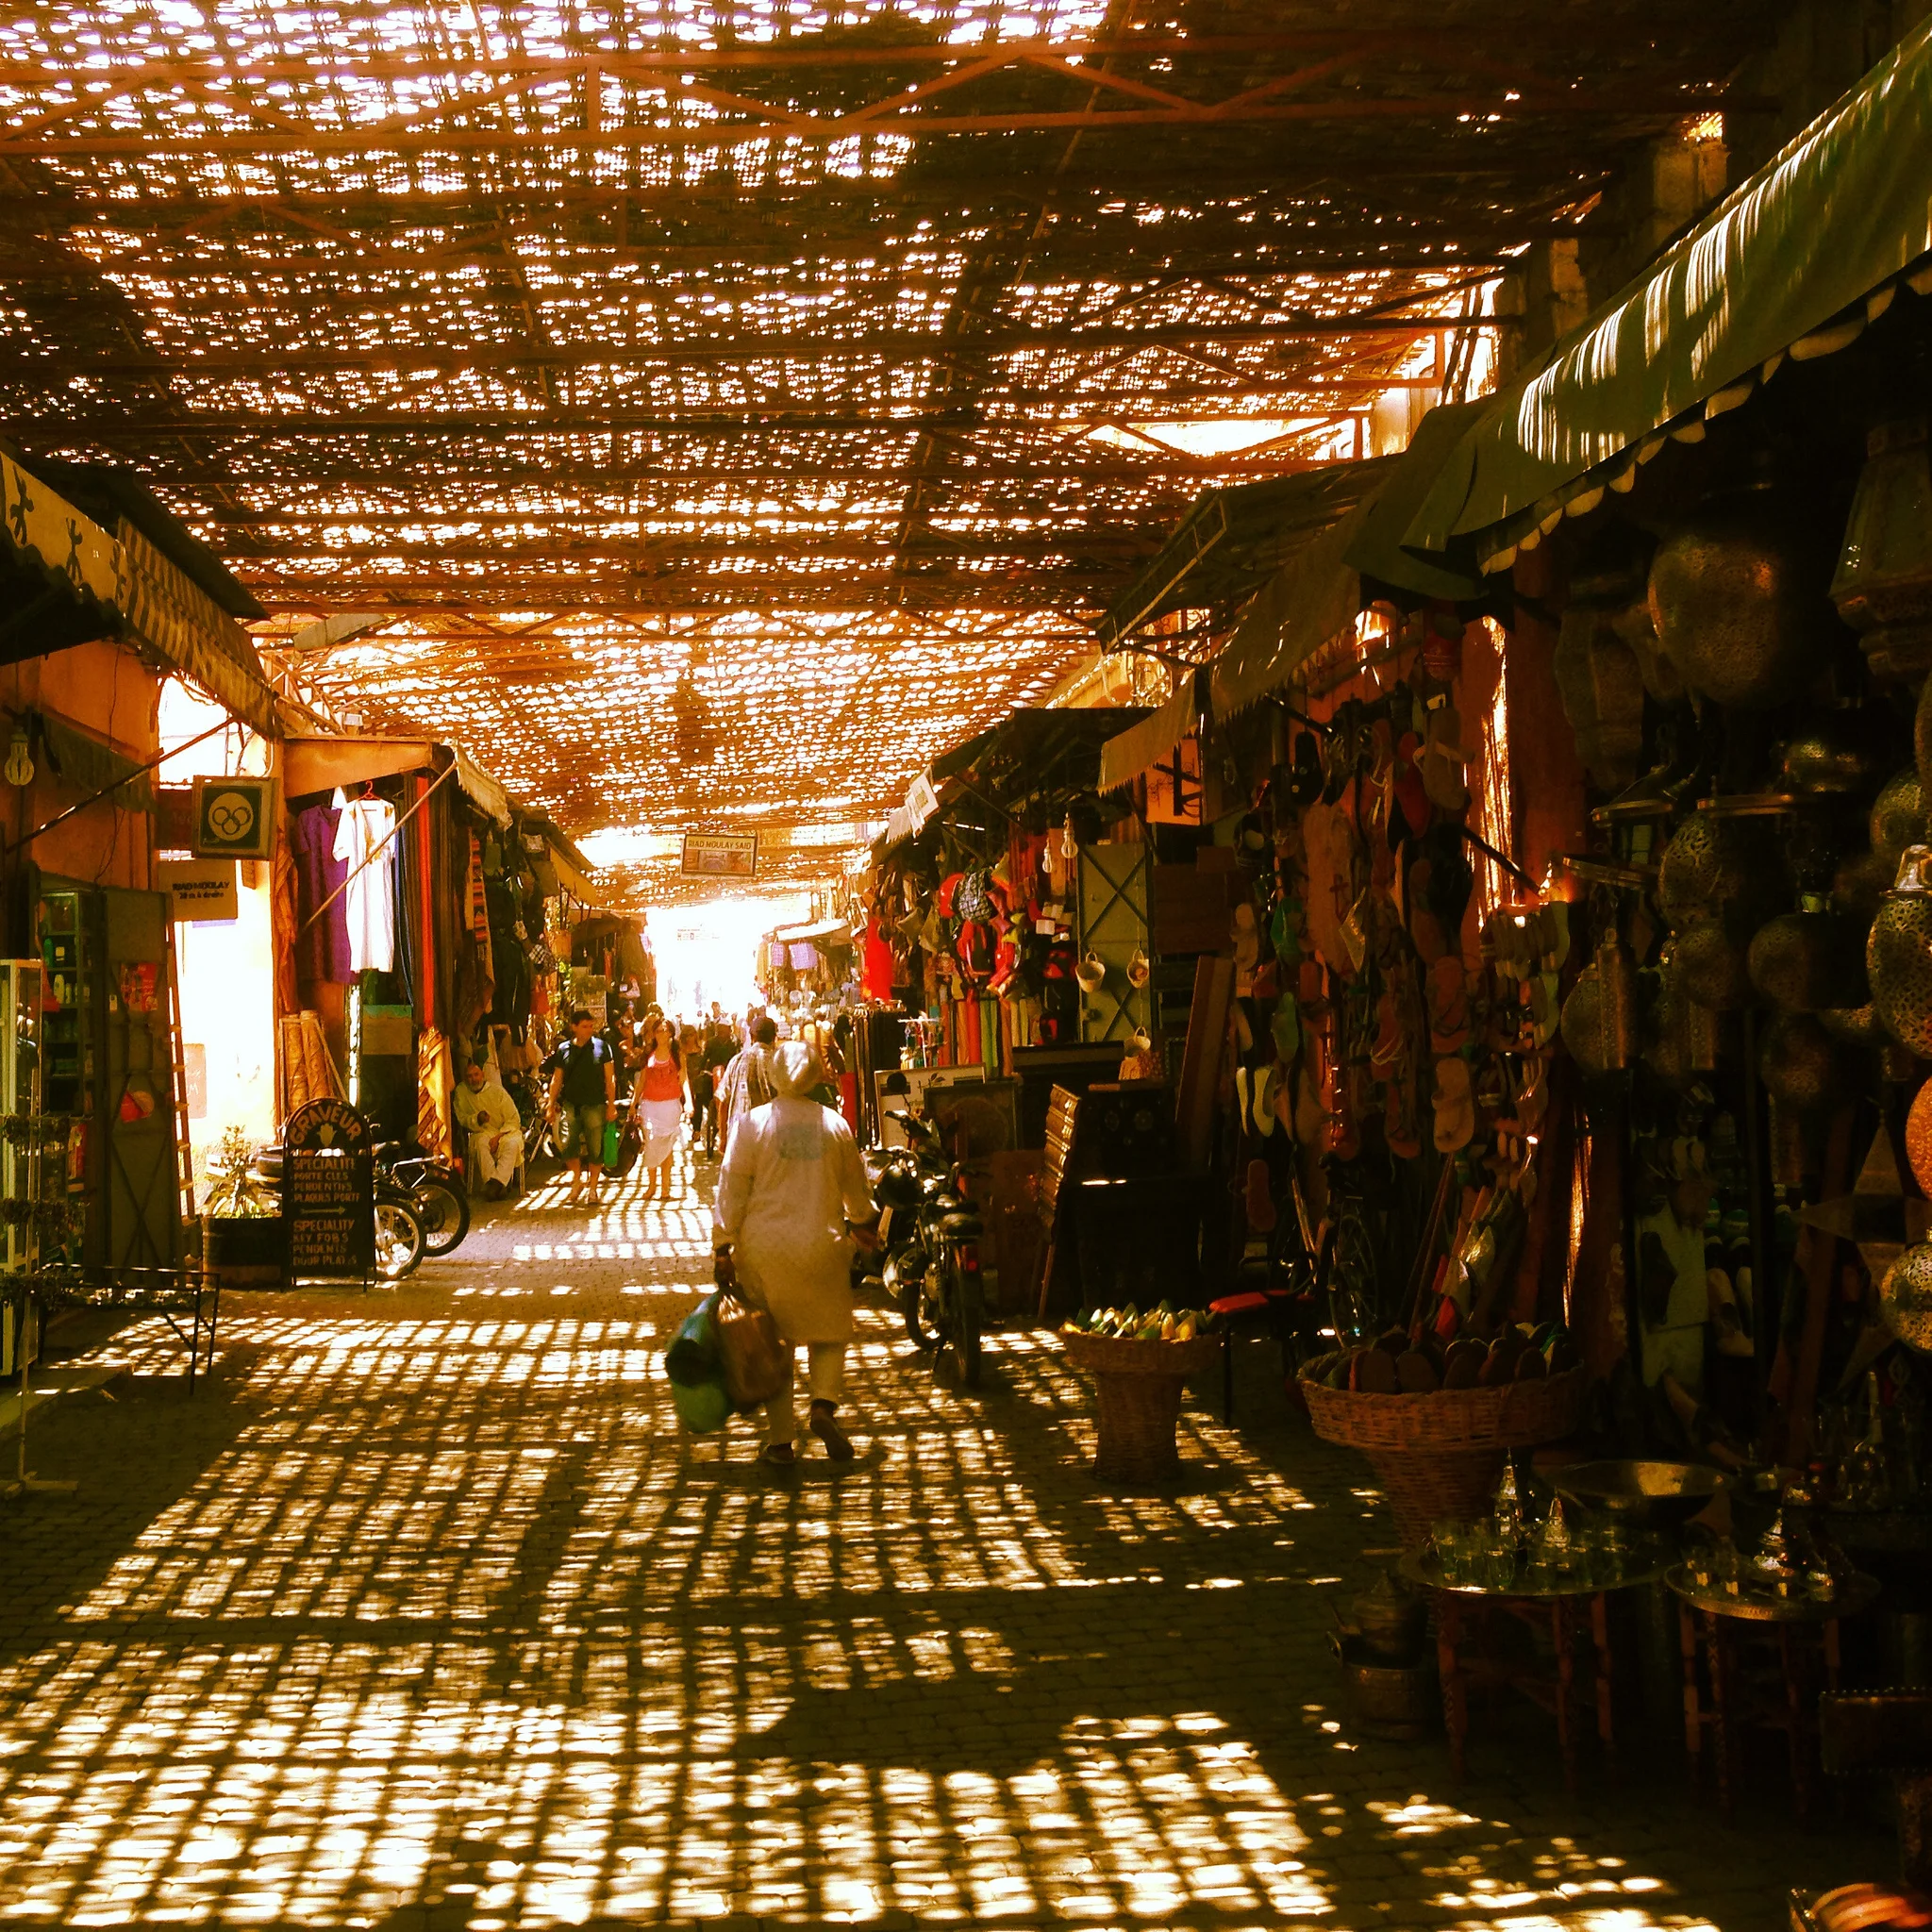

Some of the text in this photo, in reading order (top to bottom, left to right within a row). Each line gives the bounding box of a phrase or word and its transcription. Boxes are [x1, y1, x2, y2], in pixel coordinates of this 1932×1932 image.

[706, 841, 734, 849] MOULAY
[289, 1105, 362, 1144] GRAVEUR
[292, 1219, 355, 1231] SPECIALITY
[292, 1232, 349, 1243] KEY FOBS
[292, 1256, 320, 1266] DOOR
